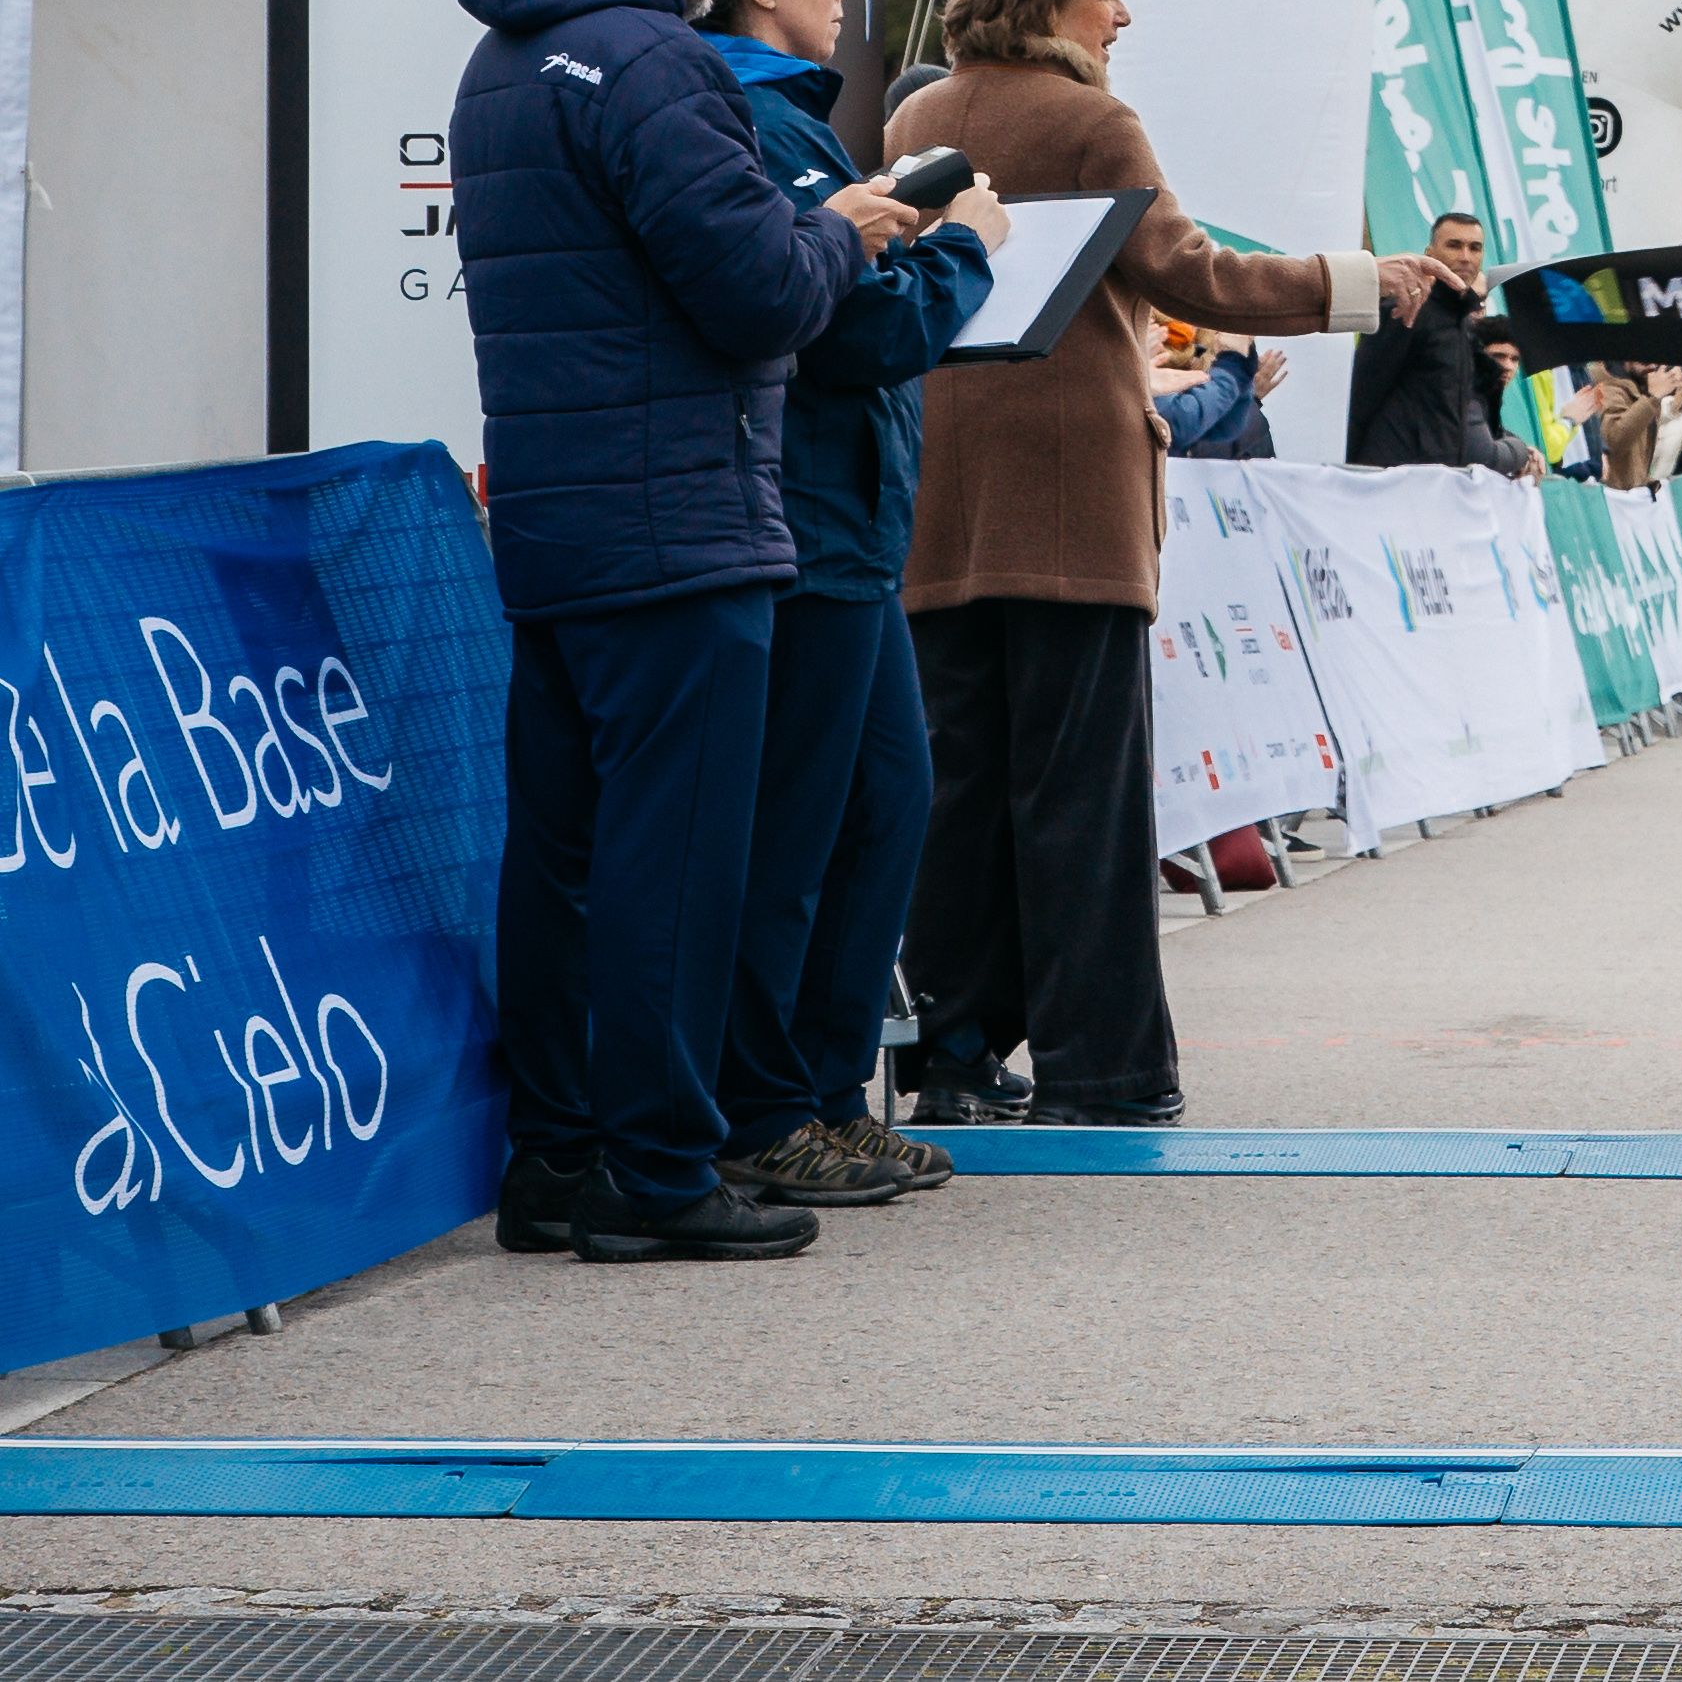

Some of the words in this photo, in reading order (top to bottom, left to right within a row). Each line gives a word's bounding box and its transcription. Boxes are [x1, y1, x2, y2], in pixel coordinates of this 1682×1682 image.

[44, 642, 180, 854] la
[139, 616, 393, 831] Base
[126, 936, 388, 1190] Cielo
